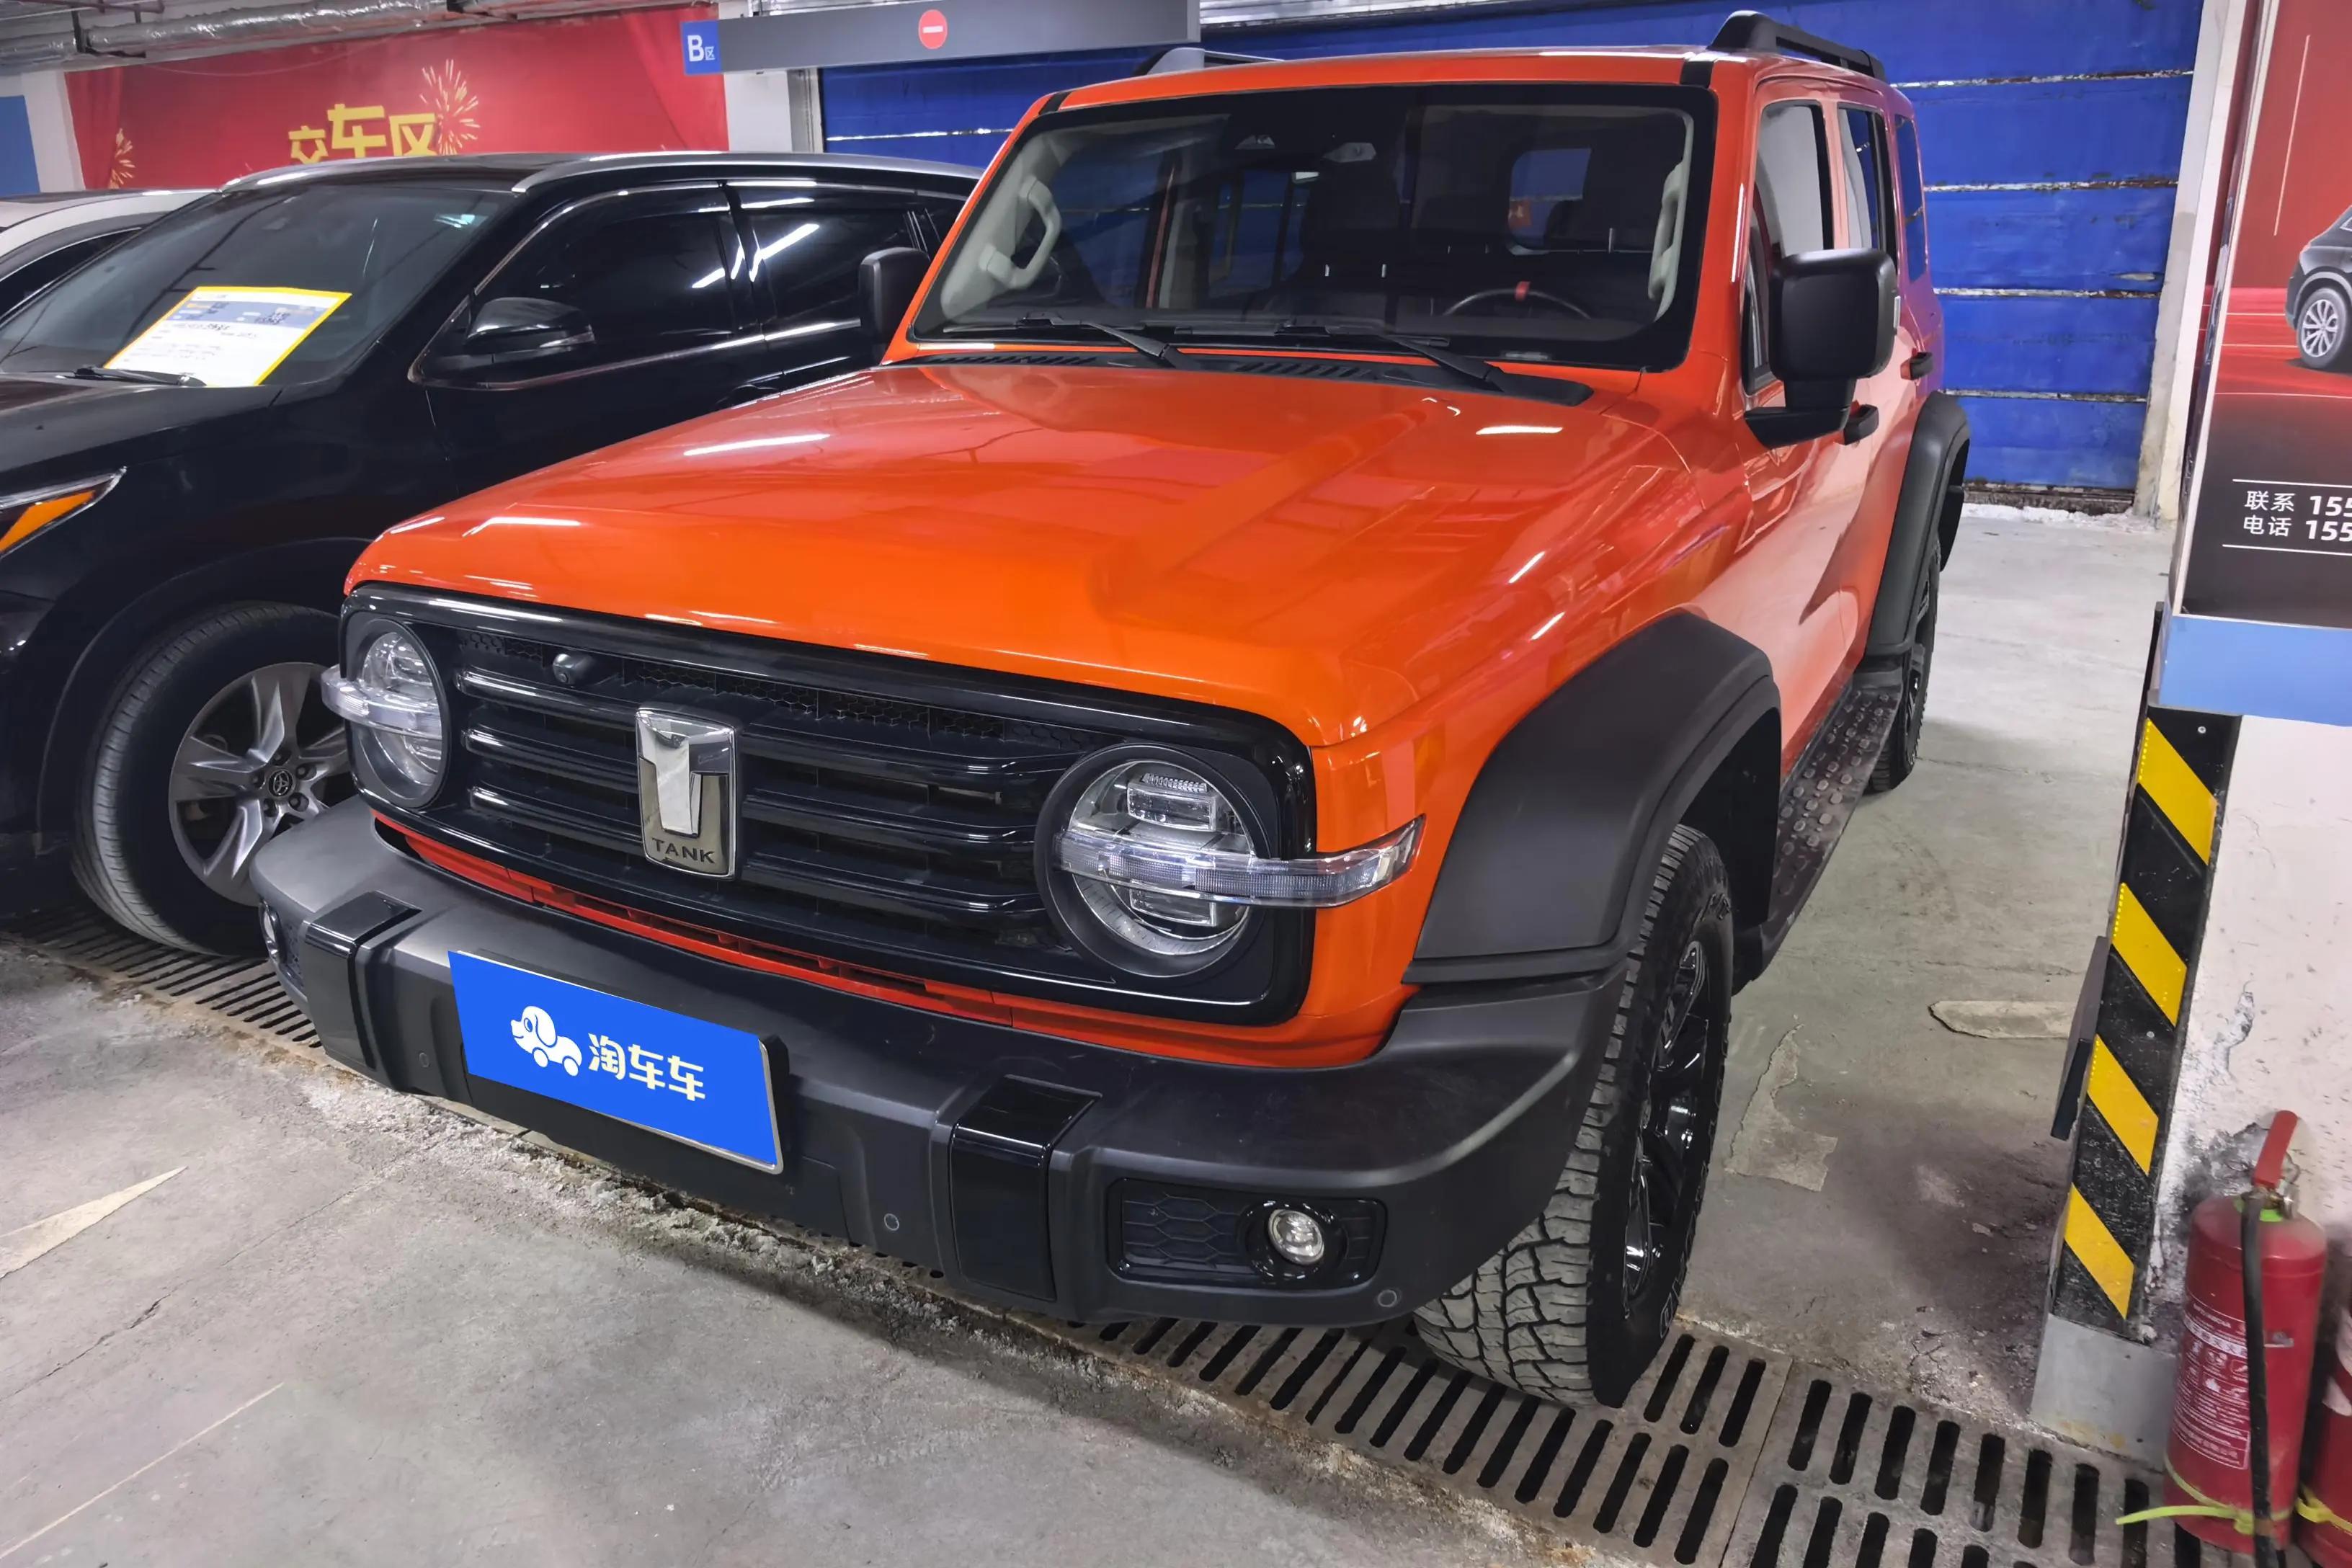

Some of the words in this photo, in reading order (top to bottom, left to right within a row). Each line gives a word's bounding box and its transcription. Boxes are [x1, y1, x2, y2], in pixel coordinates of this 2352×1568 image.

[2244, 490, 2296, 512] 联系
[2243, 514, 2292, 537] 电话
[651, 837, 716, 864] TANK
